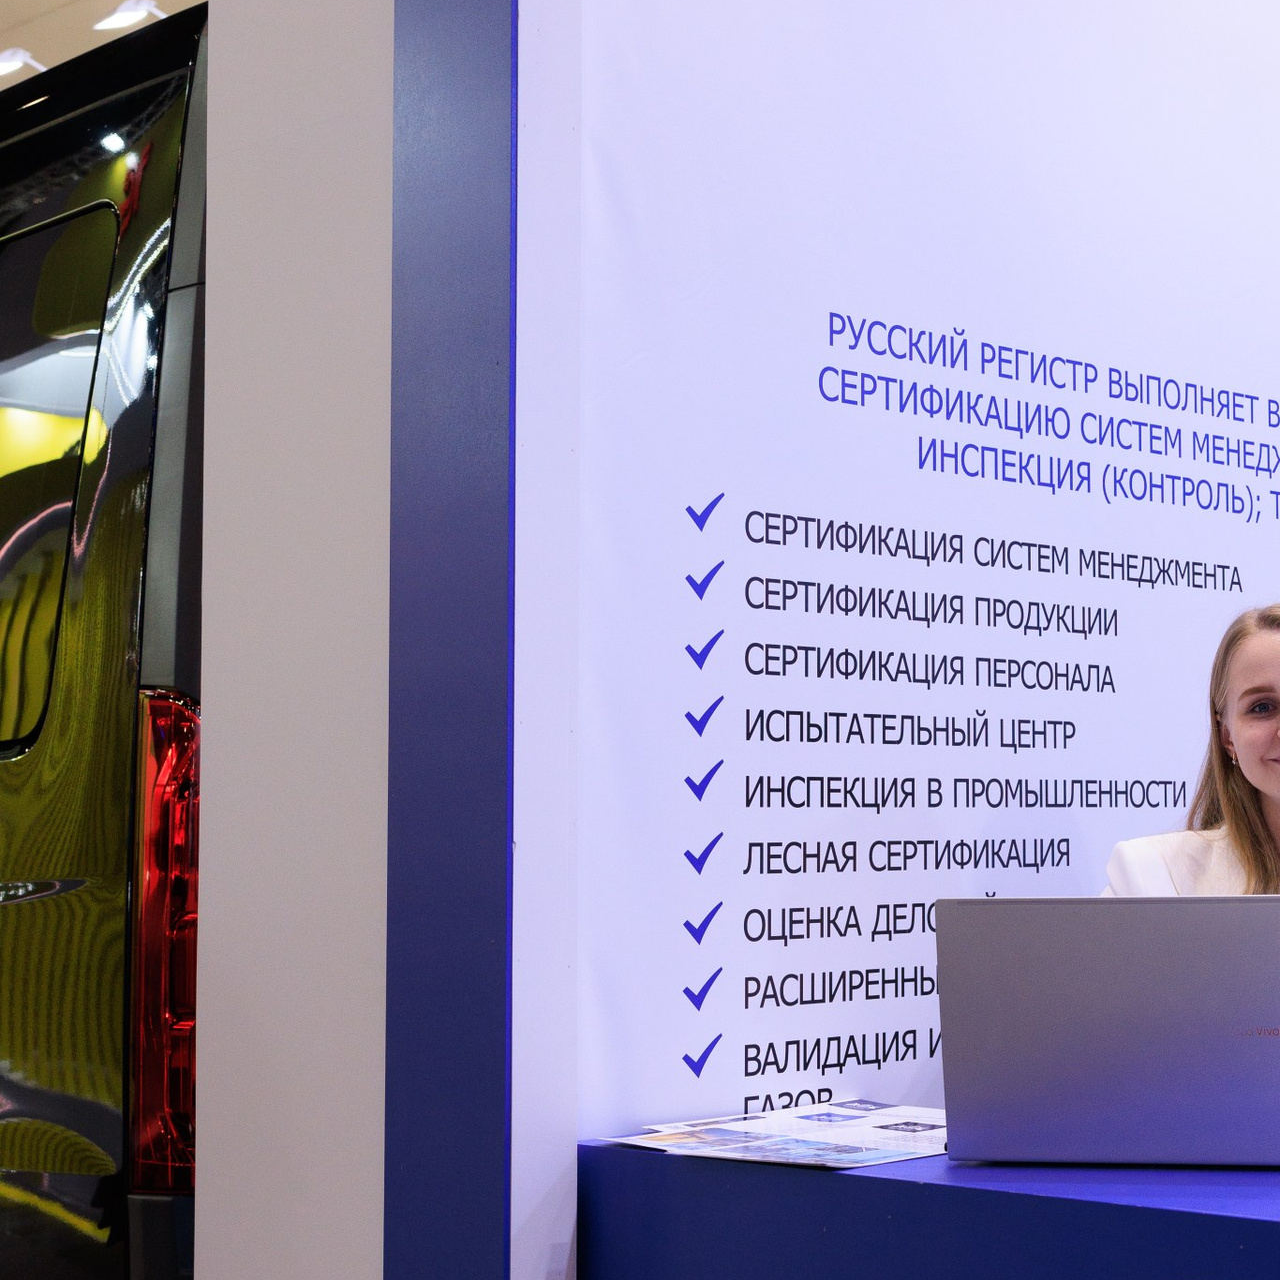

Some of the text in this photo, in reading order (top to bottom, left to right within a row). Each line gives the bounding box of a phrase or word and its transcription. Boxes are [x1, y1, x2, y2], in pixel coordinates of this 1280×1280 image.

[829, 312, 968, 371] РУССКИЙ
[981, 342, 1098, 393] РЕГИСТР
[1109, 367, 1259, 424] ВЫПОЛНЯЕТ
[818, 366, 1070, 440] СЕРТИФИКАЦИЮ
[1080, 412, 1182, 458] СИСТЕМ
[918, 436, 1091, 495] ИНСПЕКЦИЯ
[1102, 464, 1261, 523] (КОНТРОЛЬ);
[745, 511, 1243, 593] СЕРТИФИКАЦИЯ СИСТЕМ МЕНЕДЖМЕНТА
[745, 577, 1118, 639] СЕРТИФИКАЦИЯ ПРОДУКЦИИ
[745, 643, 1116, 694] СЕРТИФИКАЦИЯ ПЕРСОНАЛА
[745, 708, 1076, 754] ИСПЫТАТЕЛЬНЫЙ ЦЕНТР
[745, 776, 1187, 814] ИНСПЕКЦИЯ В ПРОМЫШЛЕННОСТИ
[743, 838, 1070, 875] ЛЕСНАЯ СЕРТИФИКАЦИЯ
[743, 906, 862, 947] ОЦЕНКА
[744, 965, 939, 1010] РАСШИРЕННЫ
[744, 1029, 917, 1077] ВАЛИДАЦИЯ
